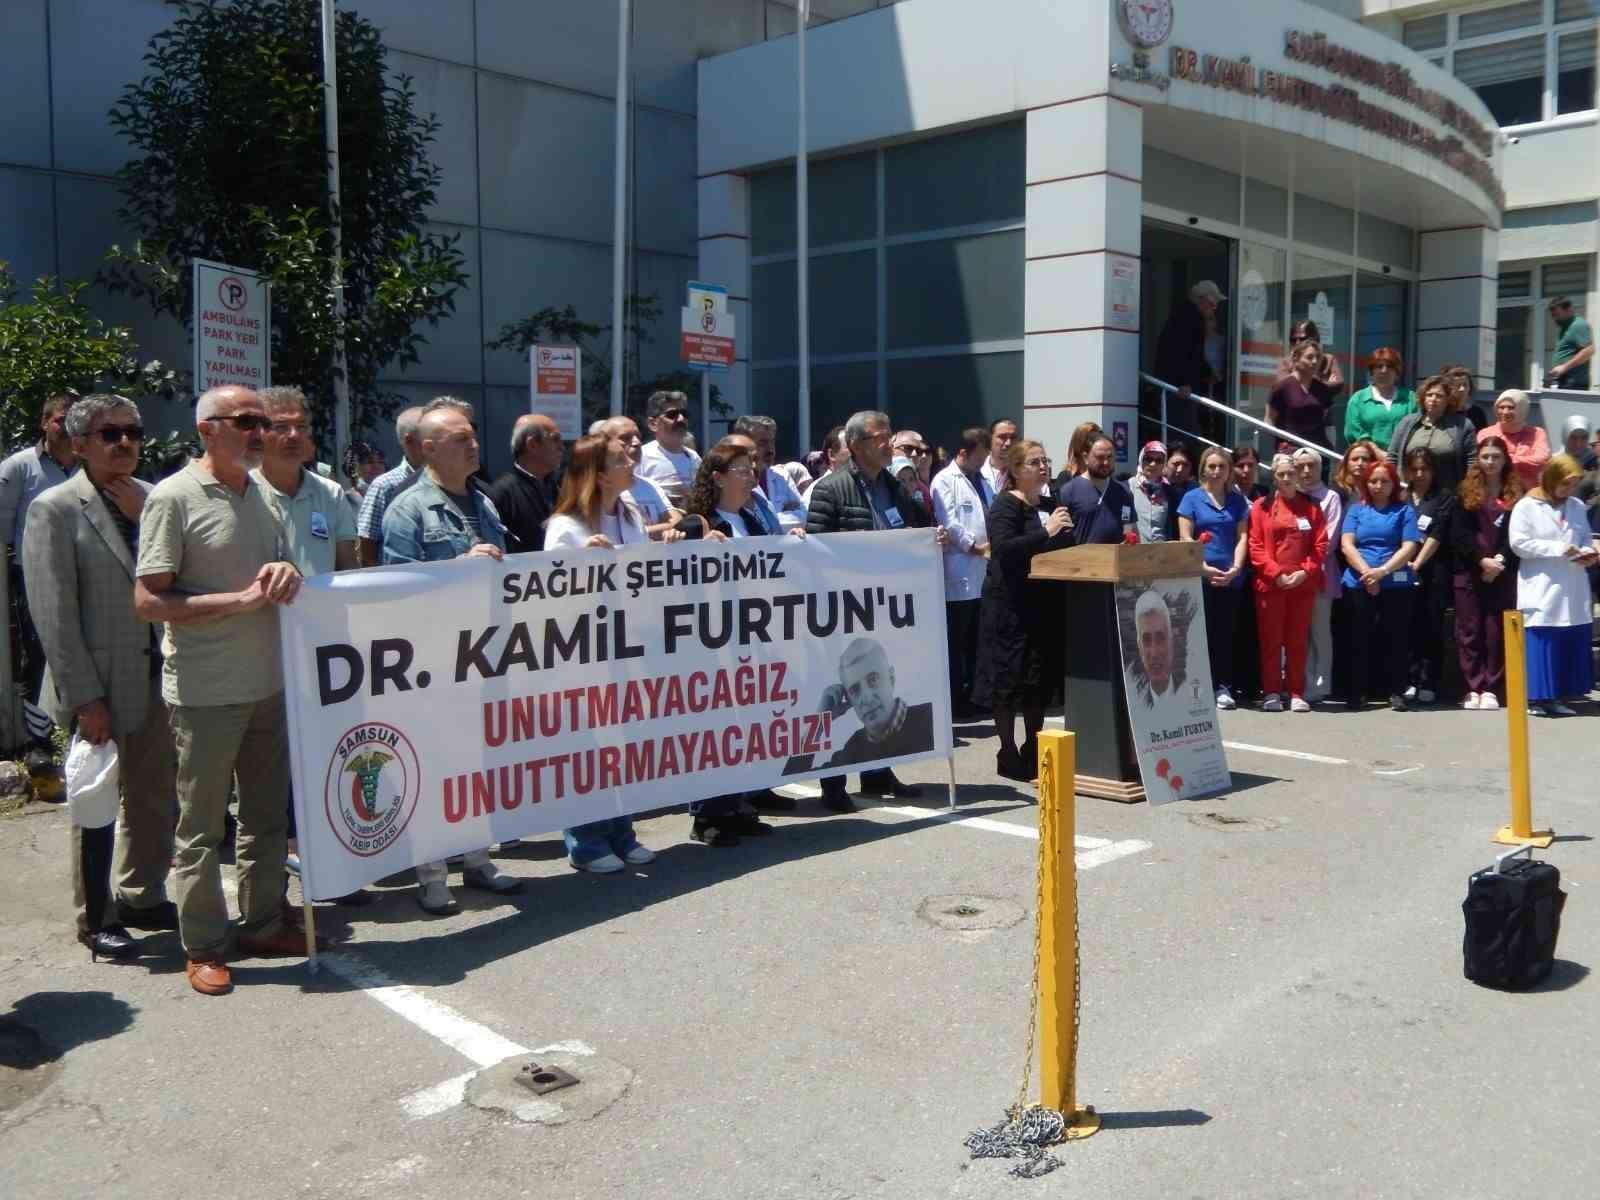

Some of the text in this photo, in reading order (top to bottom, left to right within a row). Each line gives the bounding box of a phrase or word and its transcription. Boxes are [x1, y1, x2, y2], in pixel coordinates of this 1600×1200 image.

[202, 310, 260, 329] AMBULANS
[203, 326, 233, 341] PARK
[217, 345, 247, 360] PARK
[503, 560, 617, 604] SAĞLIK
[316, 638, 431, 706] DR.
[664, 587, 915, 654] FURTUN'u
[483, 655, 798, 748] UNUTMAYACAĞIZ,
[339, 727, 400, 759] SAMSUN
[443, 709, 832, 823] UNUTTURMAYACAĞIZ!
[372, 825, 399, 849] ODASI
